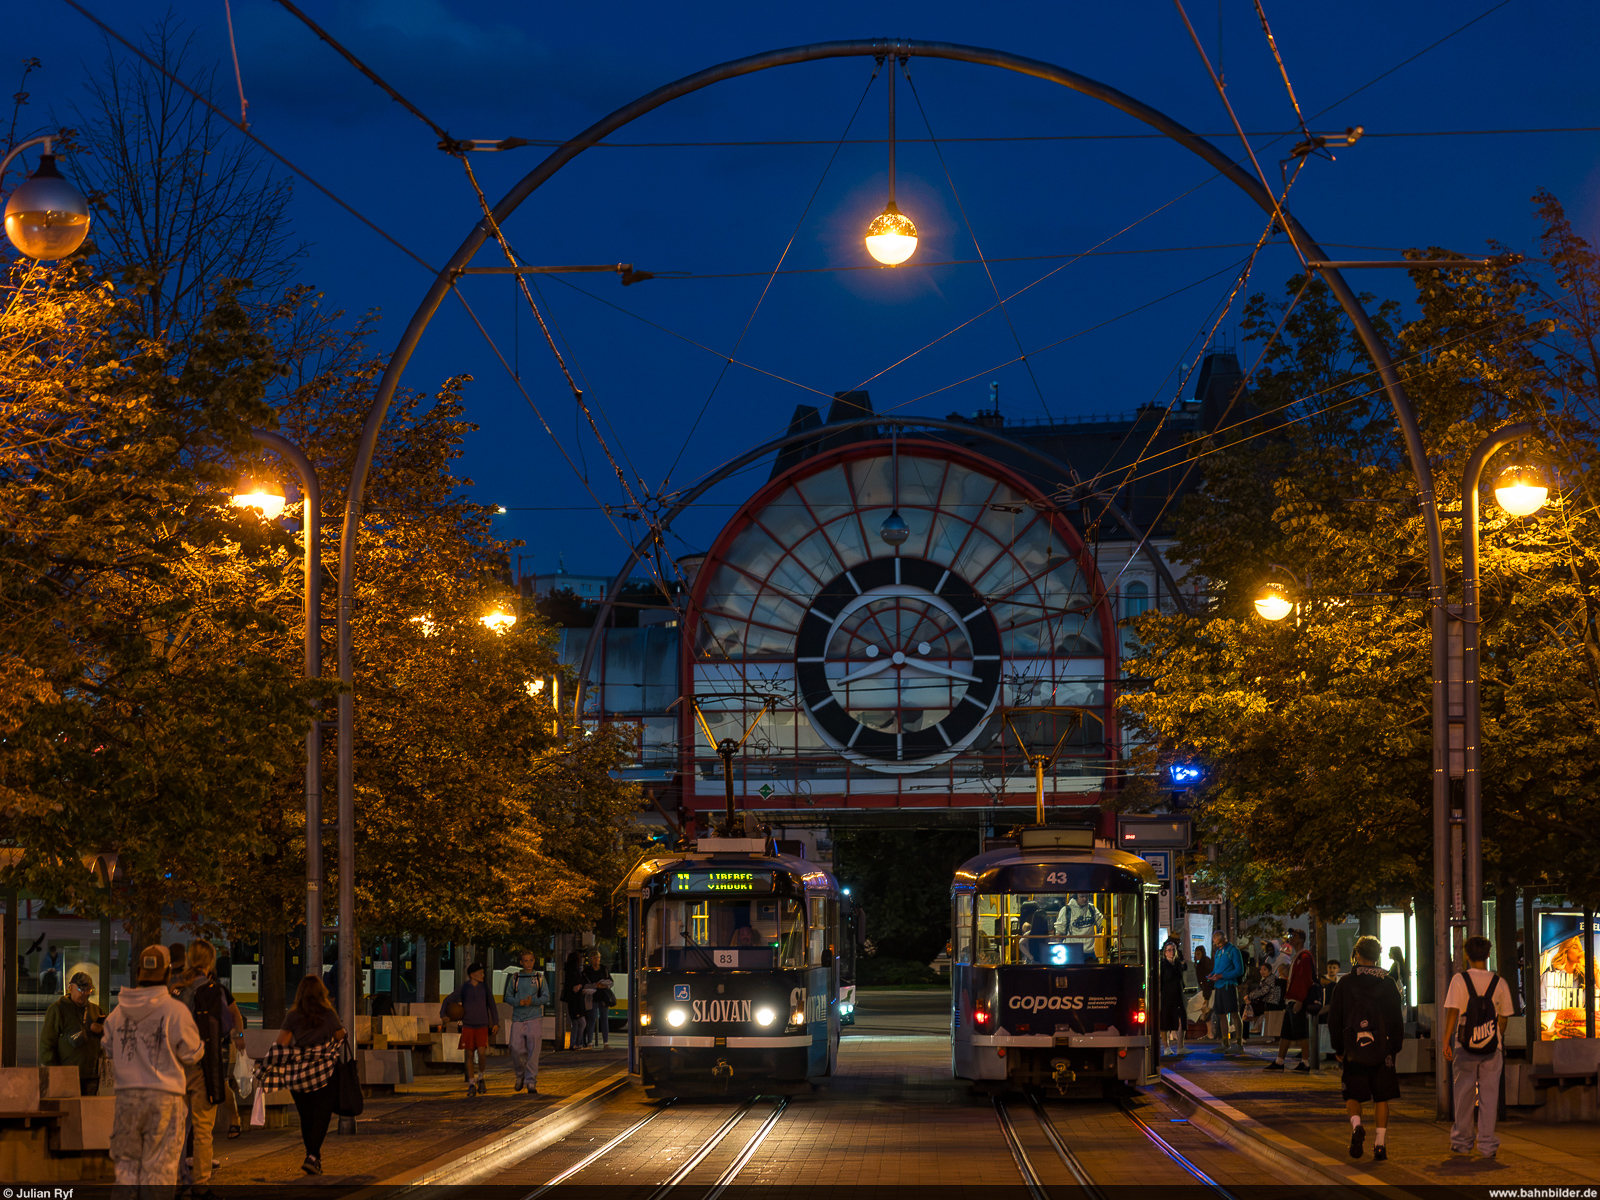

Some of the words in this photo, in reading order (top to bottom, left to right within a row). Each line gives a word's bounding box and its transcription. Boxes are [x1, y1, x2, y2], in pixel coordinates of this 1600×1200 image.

[677, 874, 690, 890] 11
[1046, 871, 1068, 884] 43
[642, 887, 651, 900] 69
[719, 954, 733, 964] 83
[1051, 944, 1067, 965] 3
[691, 999, 752, 1023] SLOVAN
[1472, 1019, 1497, 1043] NIKE
